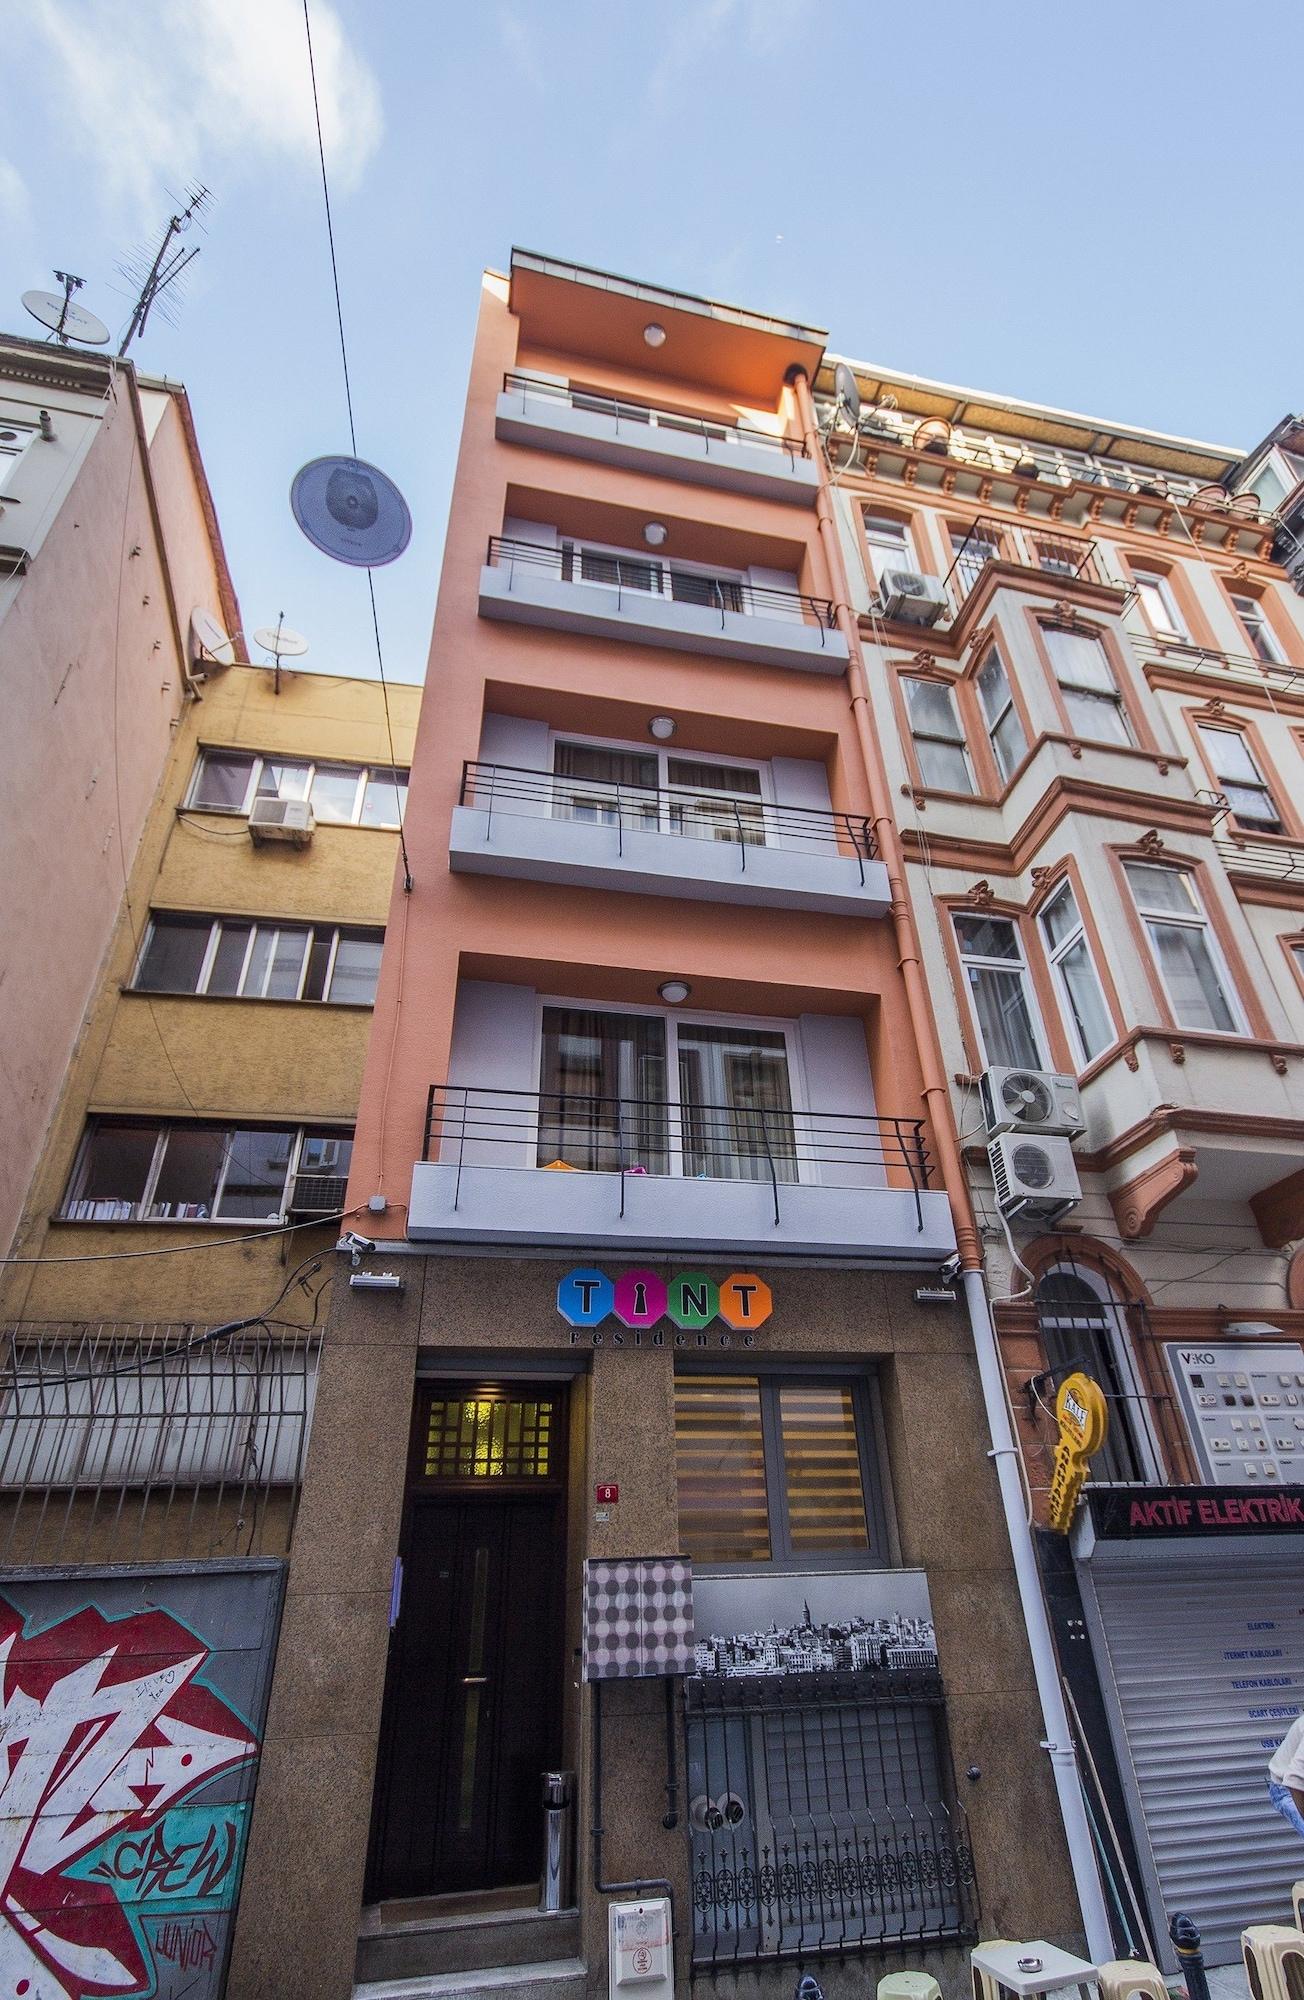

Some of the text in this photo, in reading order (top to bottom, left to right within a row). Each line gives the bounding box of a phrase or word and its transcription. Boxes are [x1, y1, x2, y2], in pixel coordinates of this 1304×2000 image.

[569, 1329, 755, 1347] residence
[604, 1487, 611, 1499] 8
[1130, 1493, 1304, 1527] AKTİF ELEKTRİK
[114, 1819, 237, 1900] CREW
